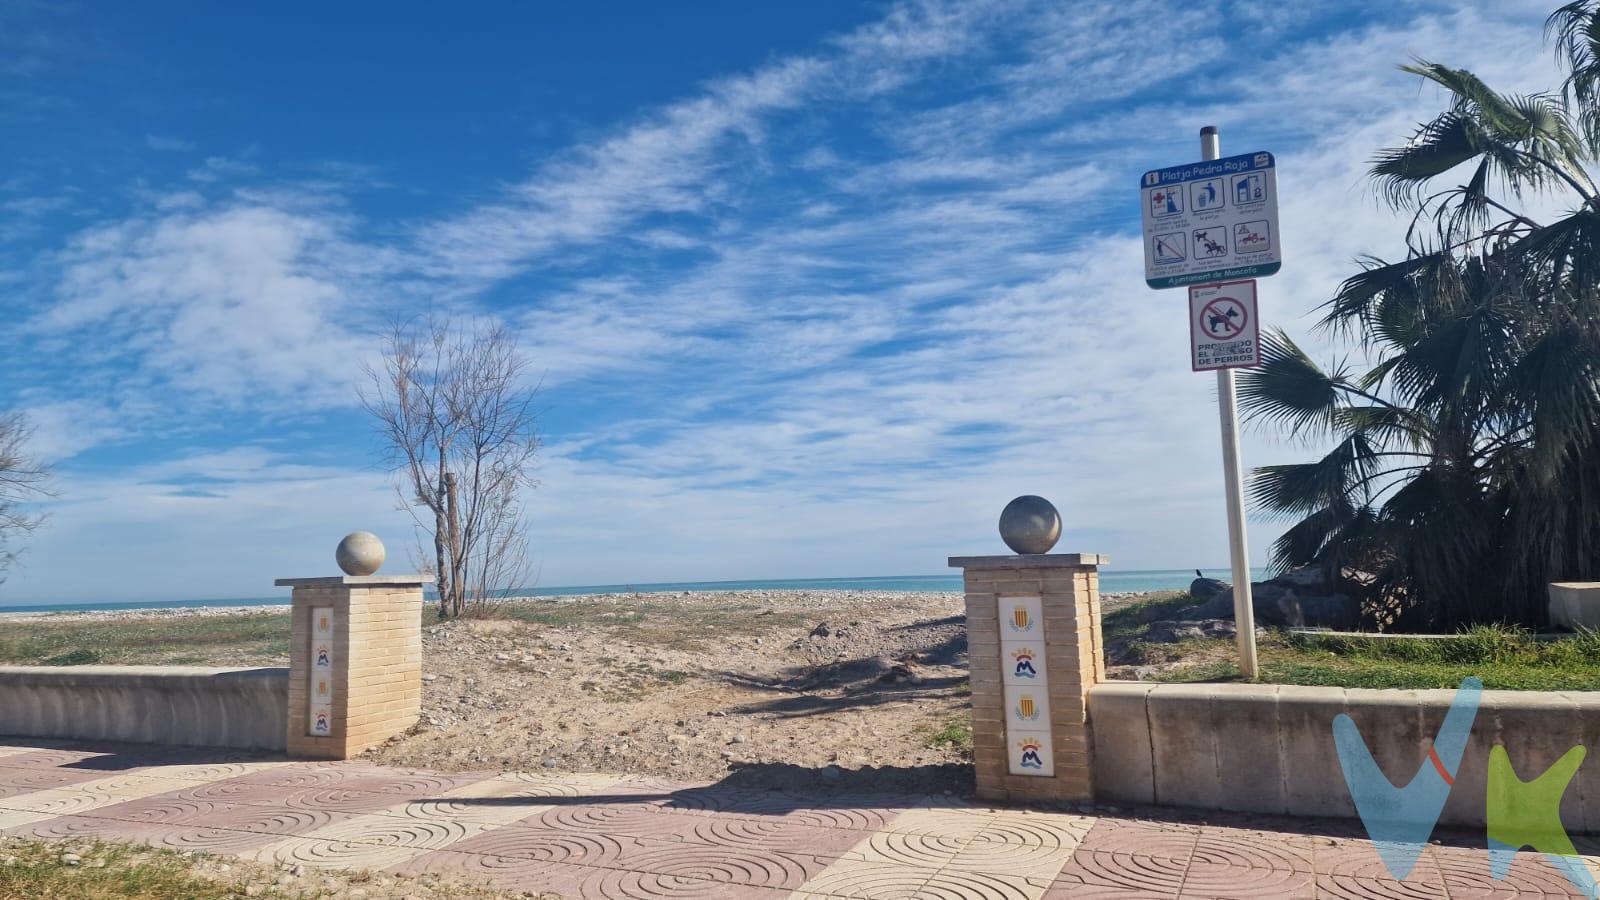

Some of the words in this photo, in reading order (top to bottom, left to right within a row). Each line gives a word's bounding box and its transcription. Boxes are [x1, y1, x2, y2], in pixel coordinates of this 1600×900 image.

[1162, 169, 1191, 182] Platja
[1193, 164, 1222, 176] Pedra
[1224, 160, 1249, 172] Roja
[1169, 273, 1212, 284] Ajuntament
[1213, 271, 1223, 279] de
[1198, 358, 1211, 366] DE
[1215, 355, 1253, 364] PERROS
